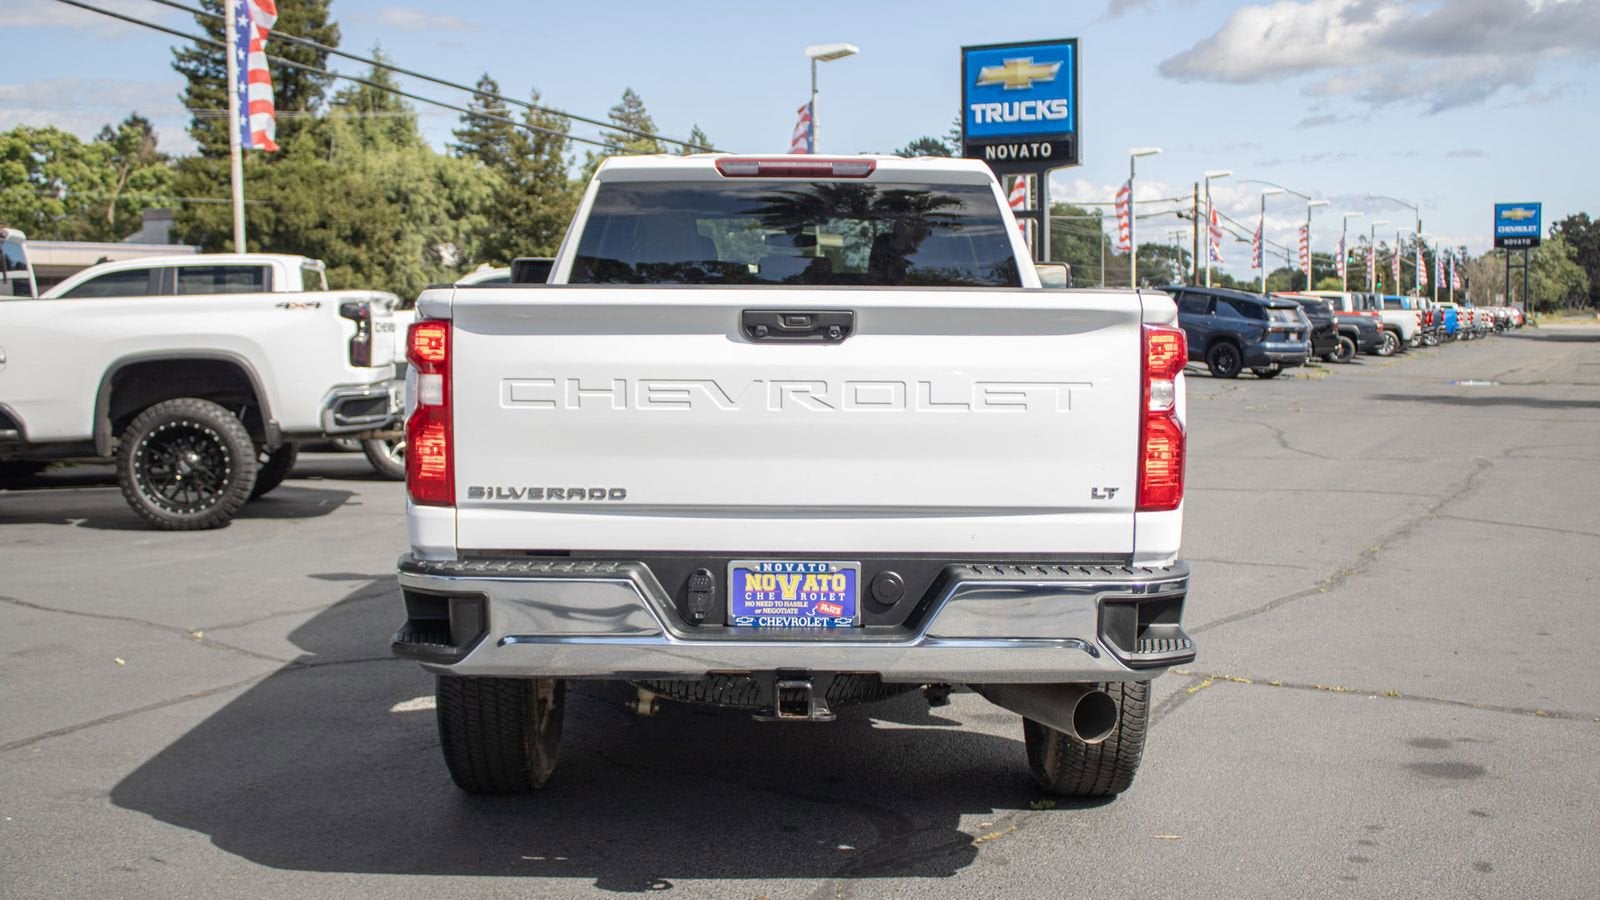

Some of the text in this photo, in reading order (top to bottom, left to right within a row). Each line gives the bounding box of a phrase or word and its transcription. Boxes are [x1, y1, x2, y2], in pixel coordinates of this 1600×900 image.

[970, 98, 1068, 124] TRUCKS
[985, 142, 1052, 160] NOVATO
[1503, 238, 1531, 246] NOVATO
[500, 378, 1093, 413] CHEVROLET
[467, 486, 627, 500] SILVERADO
[1091, 487, 1120, 500] LT
[763, 563, 827, 572] NOVATO
[745, 573, 846, 600] NOVATO
[758, 617, 829, 627] CHEVROLET
